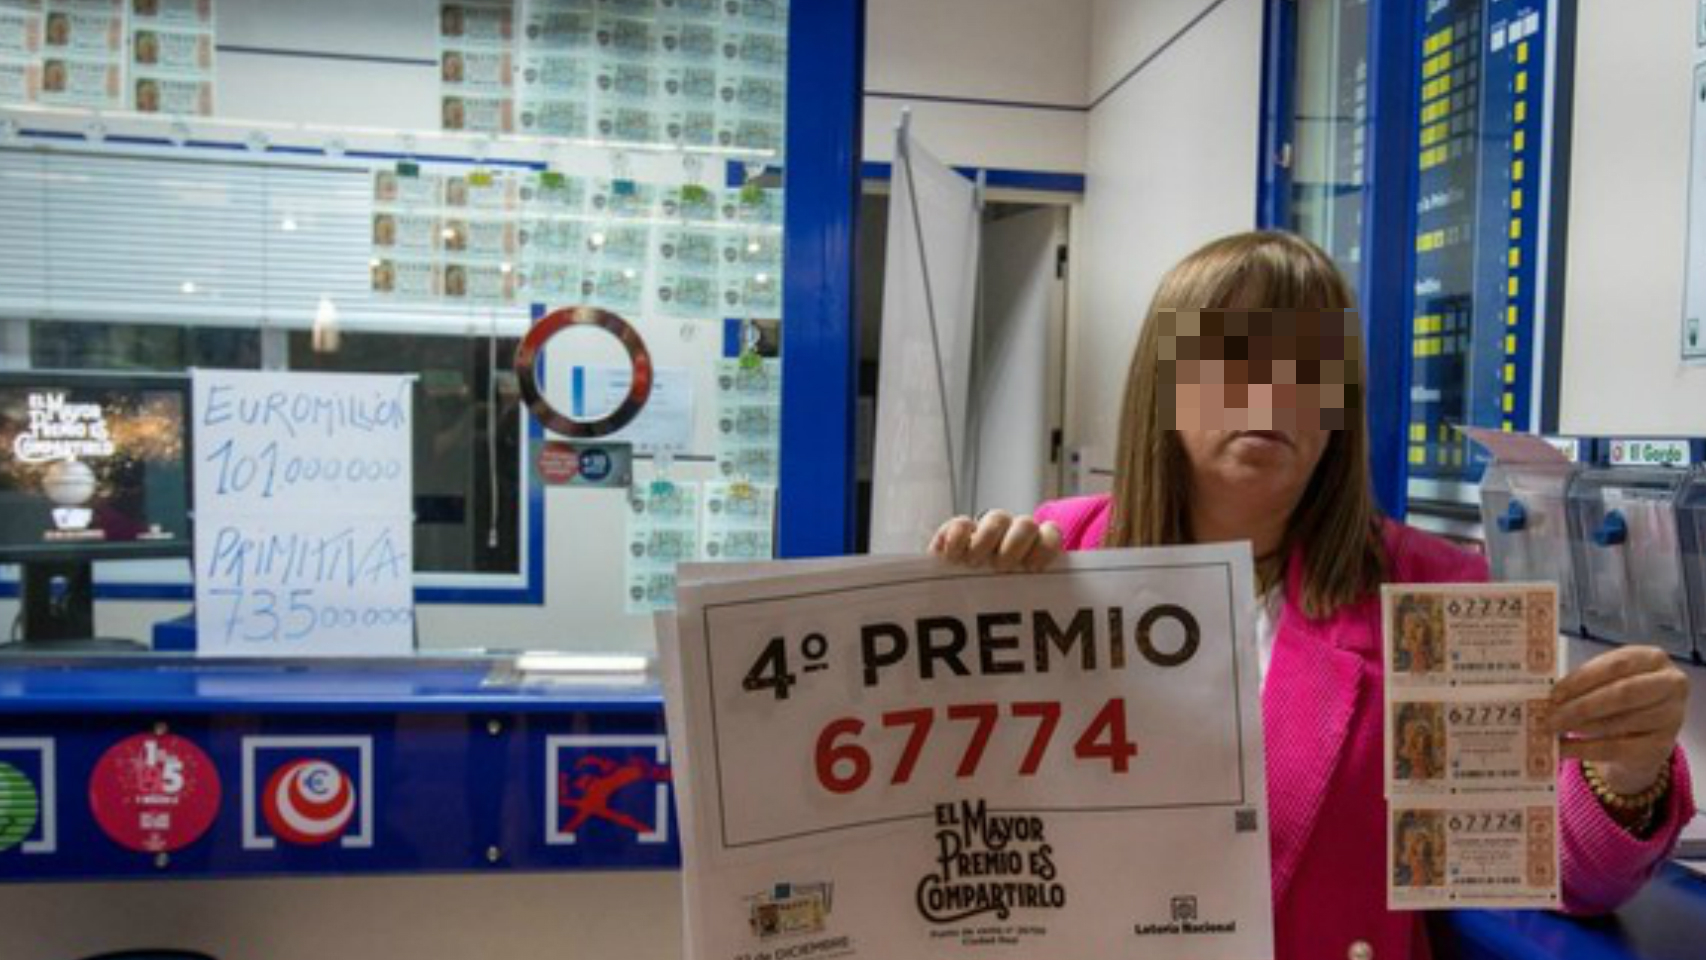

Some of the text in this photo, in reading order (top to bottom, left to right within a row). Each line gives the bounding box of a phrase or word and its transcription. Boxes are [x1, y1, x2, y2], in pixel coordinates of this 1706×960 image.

[1643, 443, 1682, 461] Gordo
[1449, 599, 1522, 618] 67774
[860, 603, 1200, 687] PREMIO
[1449, 706, 1522, 725] 67774
[813, 697, 1138, 795] 67774
[935, 799, 1044, 850] EL MAYOR
[1449, 813, 1522, 832] 67774
[935, 829, 1057, 881] PREMIO ES
[916, 874, 1066, 924] COMPARTIRLO
[1182, 920, 1236, 934] Nacional
[775, 936, 848, 960] DICIEMBRE
